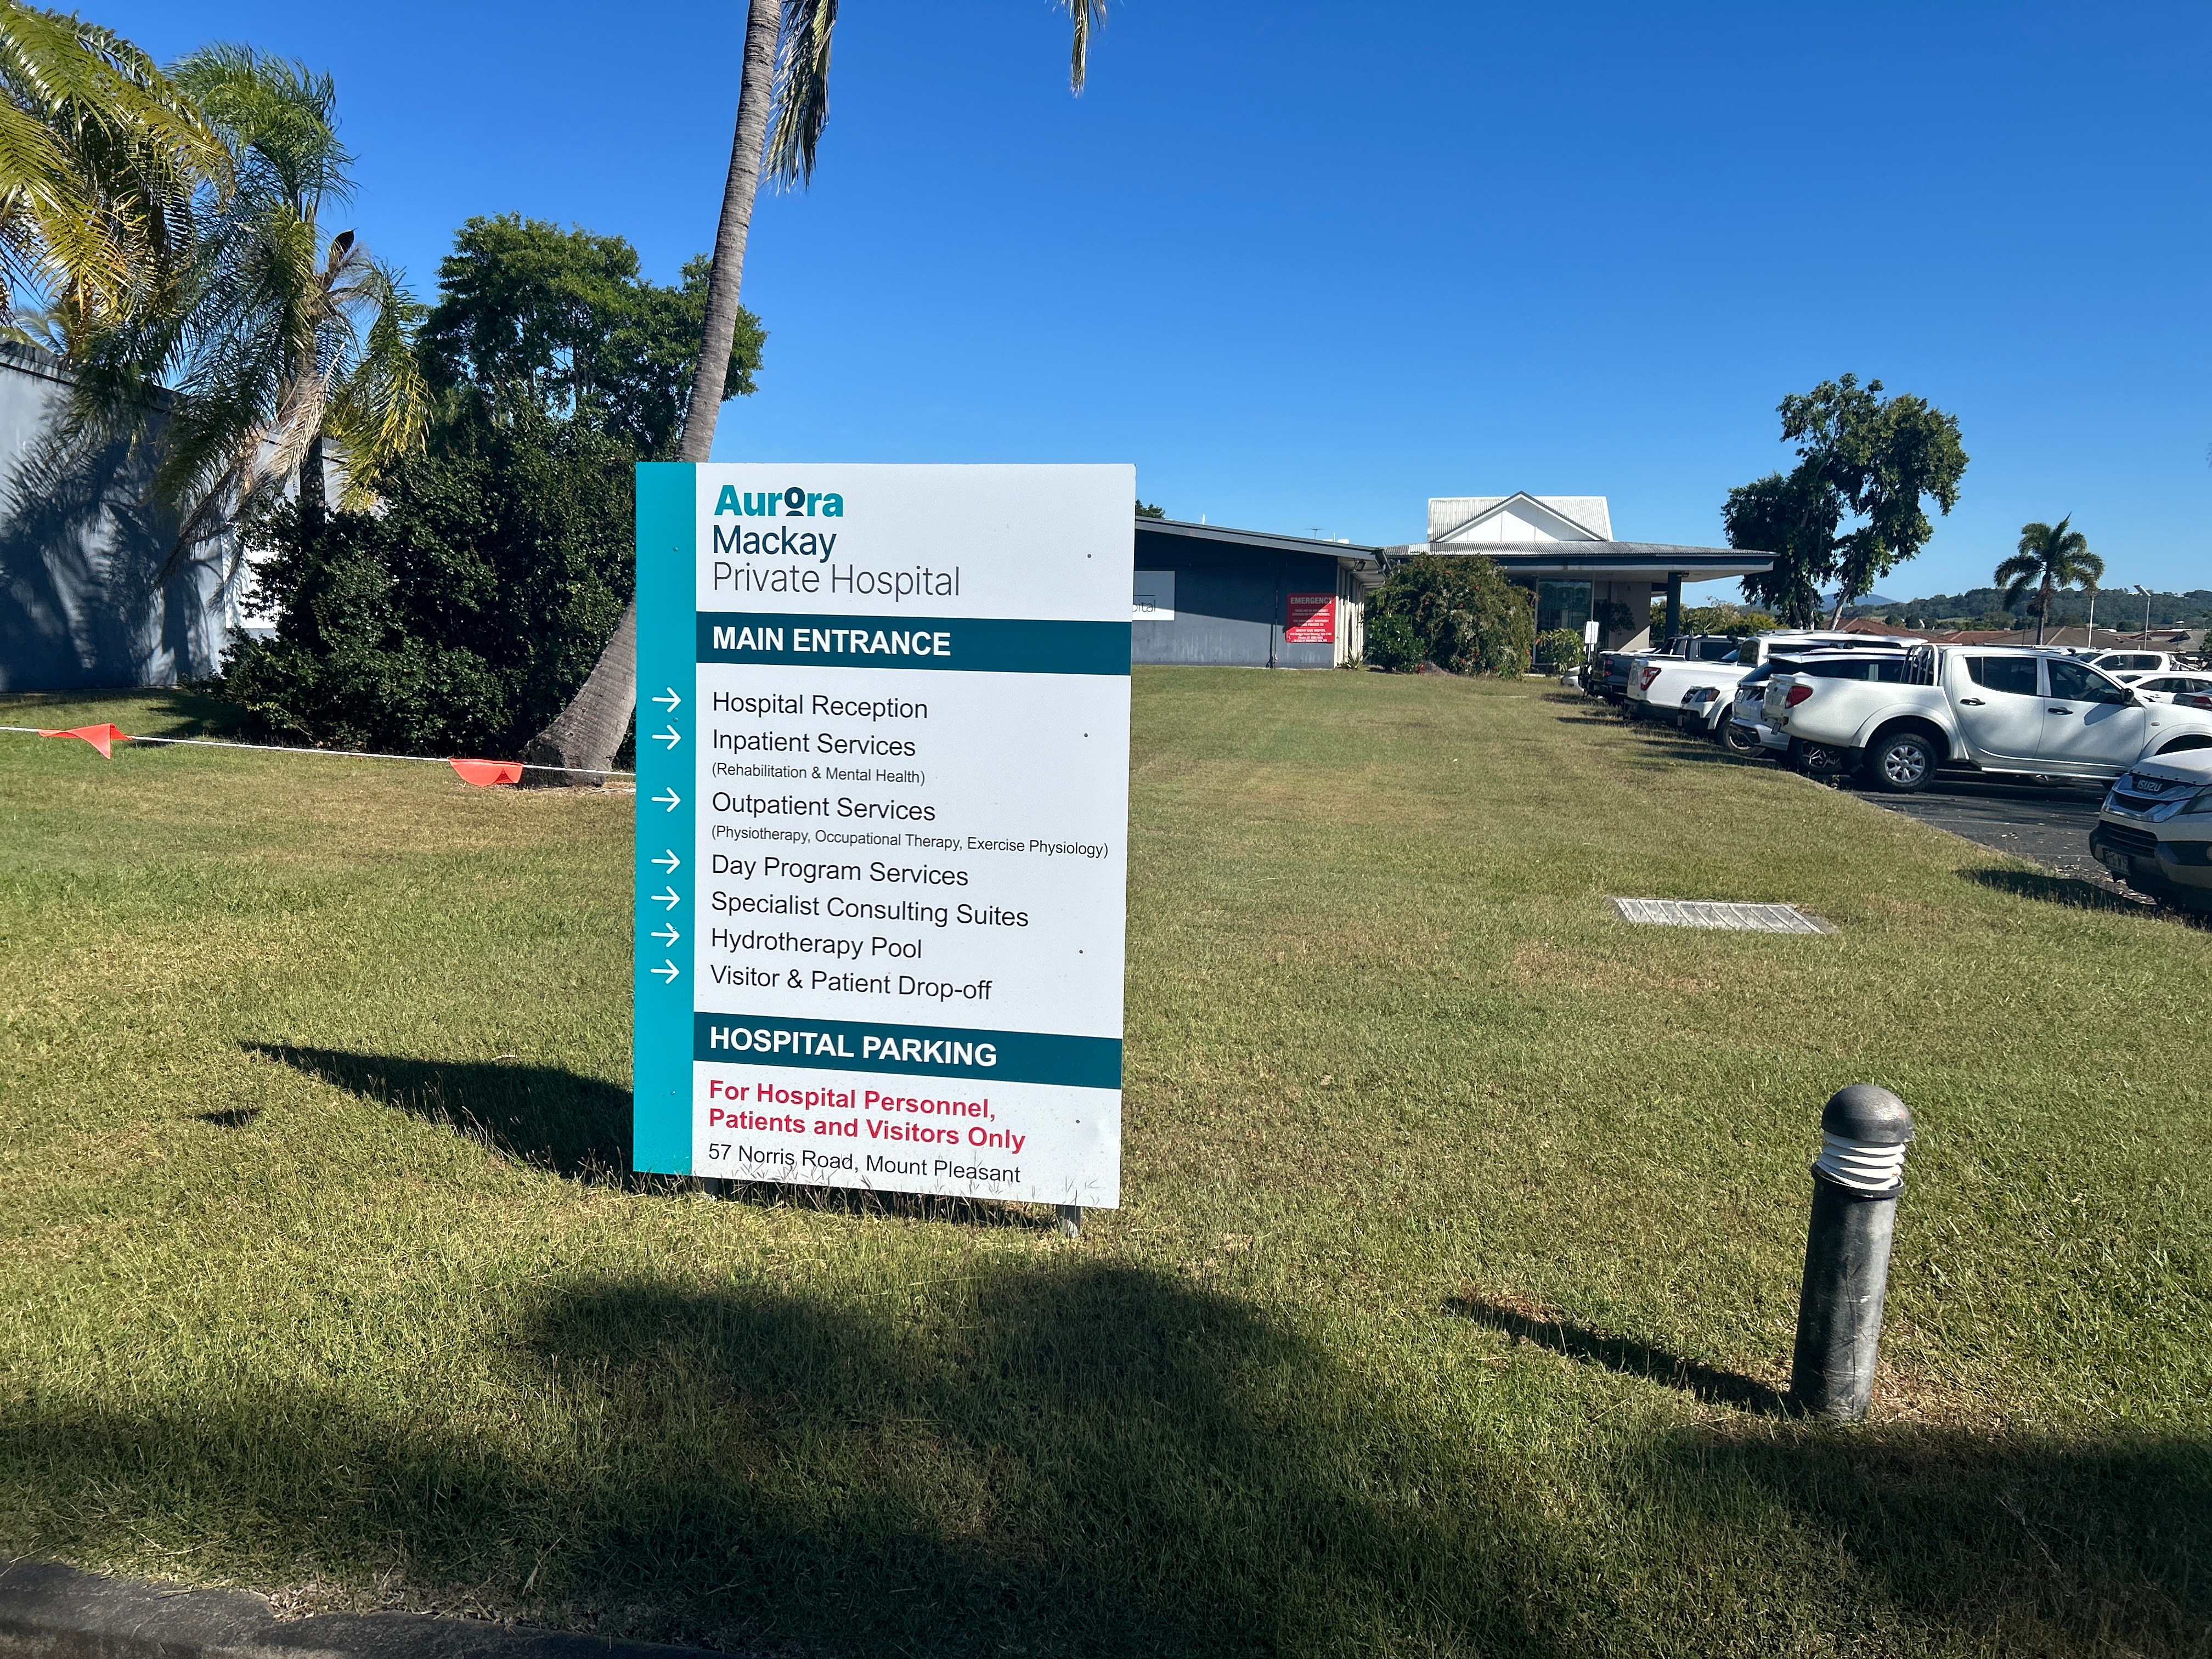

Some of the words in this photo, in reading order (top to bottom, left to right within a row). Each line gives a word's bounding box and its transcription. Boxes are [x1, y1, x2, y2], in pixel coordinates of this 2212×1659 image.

[714, 484, 844, 517] Aurora
[714, 524, 837, 562] Mackay
[714, 562, 820, 592] Private
[832, 564, 959, 602] Hospital
[713, 625, 783, 651] MAIN
[793, 628, 951, 656] ENTRANCE
[714, 691, 803, 718] Hospital
[812, 695, 927, 722] Reception
[714, 729, 810, 755] Inpatient
[817, 733, 916, 757] Services
[712, 762, 807, 778] (Rehabilitation
[811, 766, 822, 779] &
[826, 767, 871, 781] Mental
[876, 769, 925, 787] Health)
[2137, 780, 2163, 792] ISUZU
[713, 792, 830, 818] Outpatient
[837, 797, 935, 821] Services
[712, 825, 810, 844] (Physiotherapy,
[815, 830, 901, 847] Occupational
[905, 833, 962, 851] Therapy,
[968, 837, 1025, 852] Exercise
[1030, 839, 1108, 859] Physiology)
[713, 854, 757, 881] Day
[765, 856, 861, 883] Program
[870, 861, 968, 886] Services
[712, 891, 820, 916] Specialist
[827, 897, 947, 928] Consulting
[956, 904, 1029, 927] Suites
[712, 928, 864, 960] Hydrotherapy
[872, 936, 921, 958] Pool
[710, 964, 780, 987] Visitor
[787, 969, 803, 989] &
[812, 970, 890, 994] Patient
[899, 975, 993, 1002] Drop-off
[710, 1026, 854, 1058] HOSPITAL
[863, 1035, 997, 1067] PARKING
[710, 1080, 750, 1101] For
[757, 1083, 855, 1110] Hospital
[865, 1090, 995, 1122] Personnel,
[710, 1108, 805, 1133] Patients
[814, 1118, 858, 1137] and
[866, 1119, 960, 1145] Visitors
[968, 1126, 1026, 1154] Only
[709, 1143, 732, 1160] 57
[739, 1145, 795, 1166] Norris
[803, 1150, 858, 1173] Road,
[867, 1154, 927, 1176] Mount
[934, 1160, 1021, 1183] Pleasant
